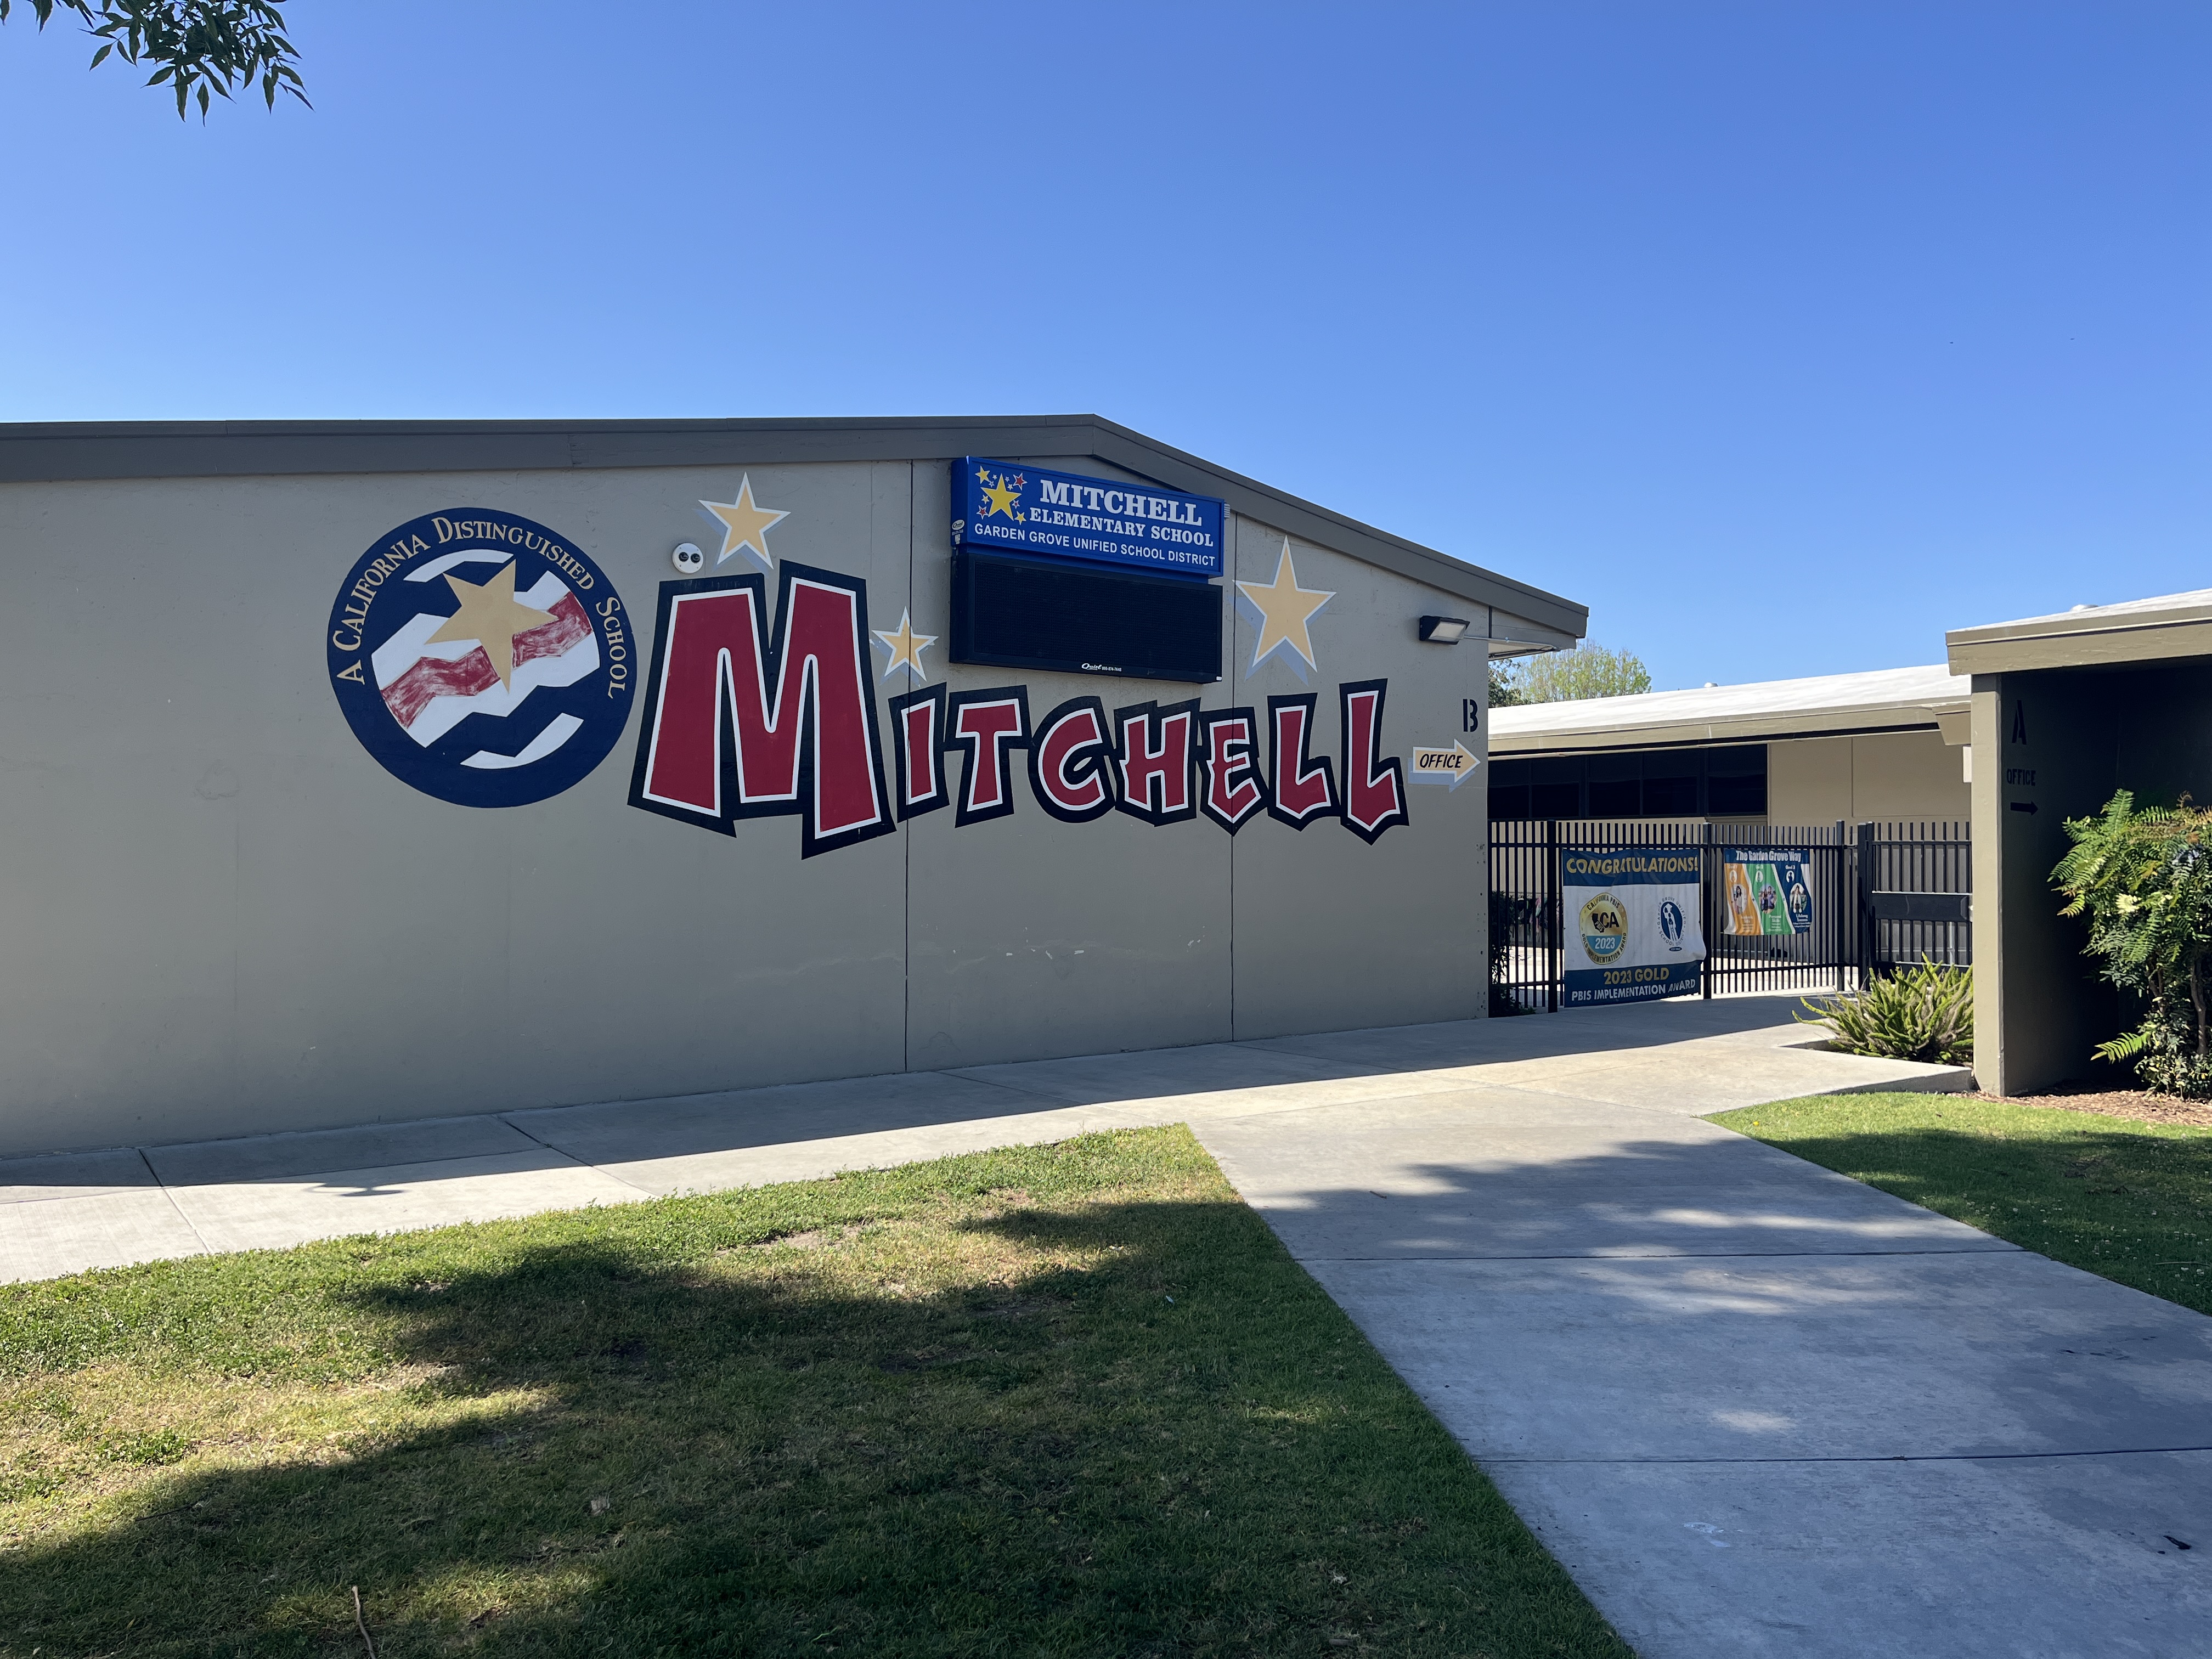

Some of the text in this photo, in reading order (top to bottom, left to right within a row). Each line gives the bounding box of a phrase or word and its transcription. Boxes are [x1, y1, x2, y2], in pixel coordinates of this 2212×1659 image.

[1040, 479, 1201, 527] MITCHELL
[1030, 507, 1214, 547] ELEMENTARY SCHOOL
[974, 523, 1025, 541] GARDEN
[1029, 531, 1070, 547] GROVE
[1073, 537, 1118, 554] UNIFIED
[1121, 544, 1165, 560] SCHOOL
[1168, 550, 1216, 567] DISTRICT
[332, 517, 628, 699] A CALIFORNIA DISTINGUISHED SCHOOL
[1463, 699, 1478, 732] B
[2012, 699, 2027, 745] A
[1420, 754, 1463, 768] OFFICE
[2007, 769, 2036, 786] OFFICE
[1736, 850, 1748, 861] The
[1769, 850, 1788, 861] Grove
[1788, 851, 1801, 862] Way
[1566, 857, 1699, 874] CONGRATULATIONS!
[1587, 894, 1609, 910] CALIFORNIA
[1600, 912, 1620, 928] CA
[1595, 937, 1615, 949] 2023
[1604, 967, 1669, 985] 2023 GOLD
[1571, 979, 1696, 1001] PBIS IMPLEMENTATION AWARD
